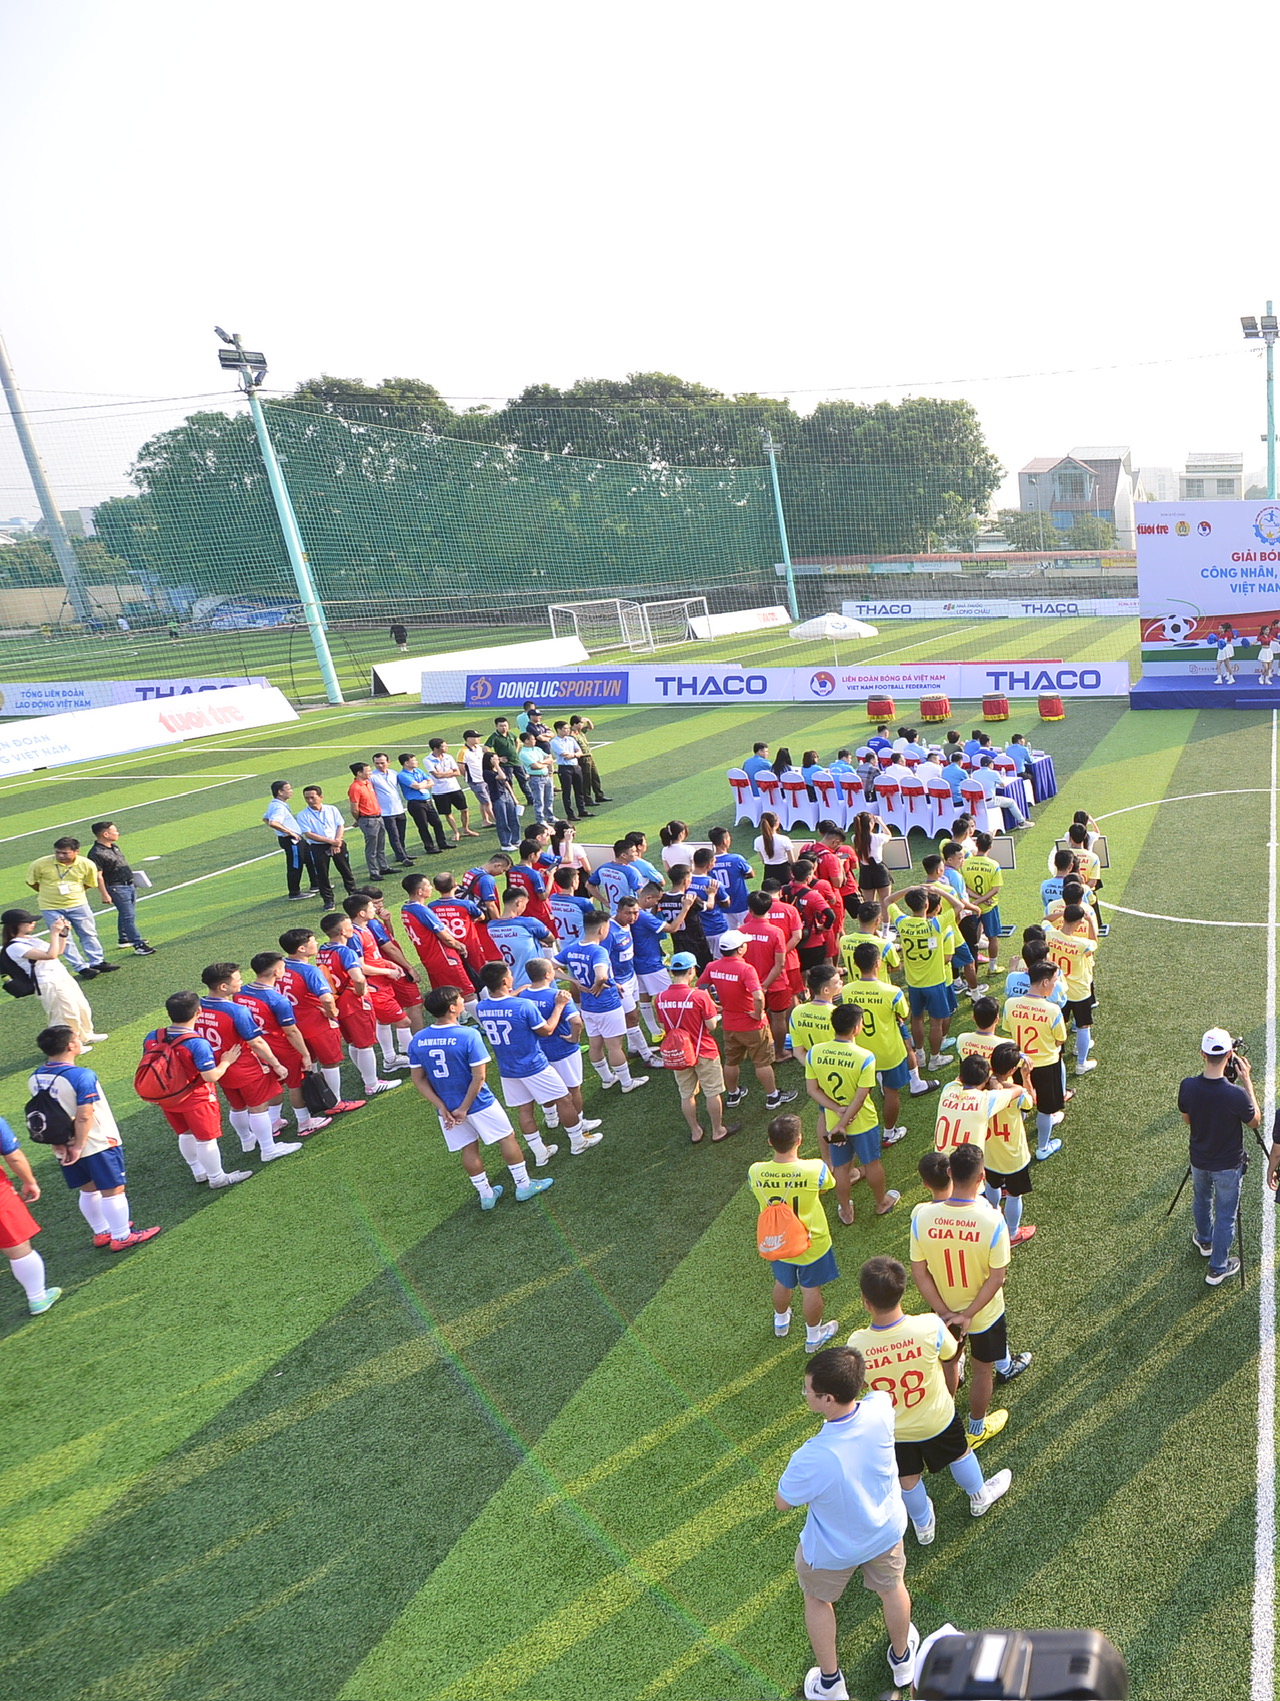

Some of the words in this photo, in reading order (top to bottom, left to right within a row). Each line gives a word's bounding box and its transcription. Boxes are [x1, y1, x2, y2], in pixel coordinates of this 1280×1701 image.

[1231, 549, 1256, 562] GIẢI
[1201, 566, 1237, 578] CÔNG
[1240, 565, 1278, 579] NHÂN,
[1230, 581, 1255, 596] VIỆT
[855, 604, 911, 615] THACO
[1021, 603, 1078, 613] THACO
[654, 675, 768, 696] THACO
[902, 674, 911, 682] ĐÁ
[913, 674, 928, 682] VIỆT
[986, 669, 1101, 690] THACO
[497, 678, 622, 699] DONGLUCSPORT.VN
[15, 701, 30, 709] LAO
[974, 875, 983, 895] 8
[604, 882, 619, 904] 12
[554, 916, 579, 940] 24
[500, 944, 515, 967] 6
[903, 938, 933, 961] 25
[1048, 941, 1062, 950] GIA
[1065, 947, 1079, 955] LAI
[725, 974, 739, 982] NAM
[1012, 987, 1029, 995] GIA
[678, 1001, 693, 1009] NAM
[867, 996, 883, 1005] KHÍ
[504, 1009, 512, 1017] FC
[1012, 1010, 1030, 1020] GIA
[1033, 1013, 1048, 1023] LAI
[862, 1009, 875, 1037] 9
[197, 1027, 221, 1052] 19
[482, 1020, 512, 1045] 87
[1017, 1025, 1038, 1054] 12
[448, 1037, 456, 1046] FC
[428, 1048, 449, 1078] 3
[838, 1059, 855, 1069] KHÍ
[827, 1072, 846, 1101] 2
[942, 1099, 959, 1111] GIA
[961, 1100, 979, 1112] LAI
[935, 1115, 970, 1150] 04
[785, 1179, 808, 1189] KHÍ
[934, 1217, 954, 1226] CÔNG
[956, 1218, 977, 1228] ĐOÀN
[764, 1234, 784, 1246] NIKE
[928, 1228, 954, 1239] GIA
[959, 1229, 981, 1243] LAI
[944, 1248, 968, 1288] 11
[865, 1344, 888, 1357] CÔNG
[890, 1338, 914, 1351] ĐOÀN
[865, 1355, 893, 1370] GIA
[897, 1346, 922, 1363] LAI
